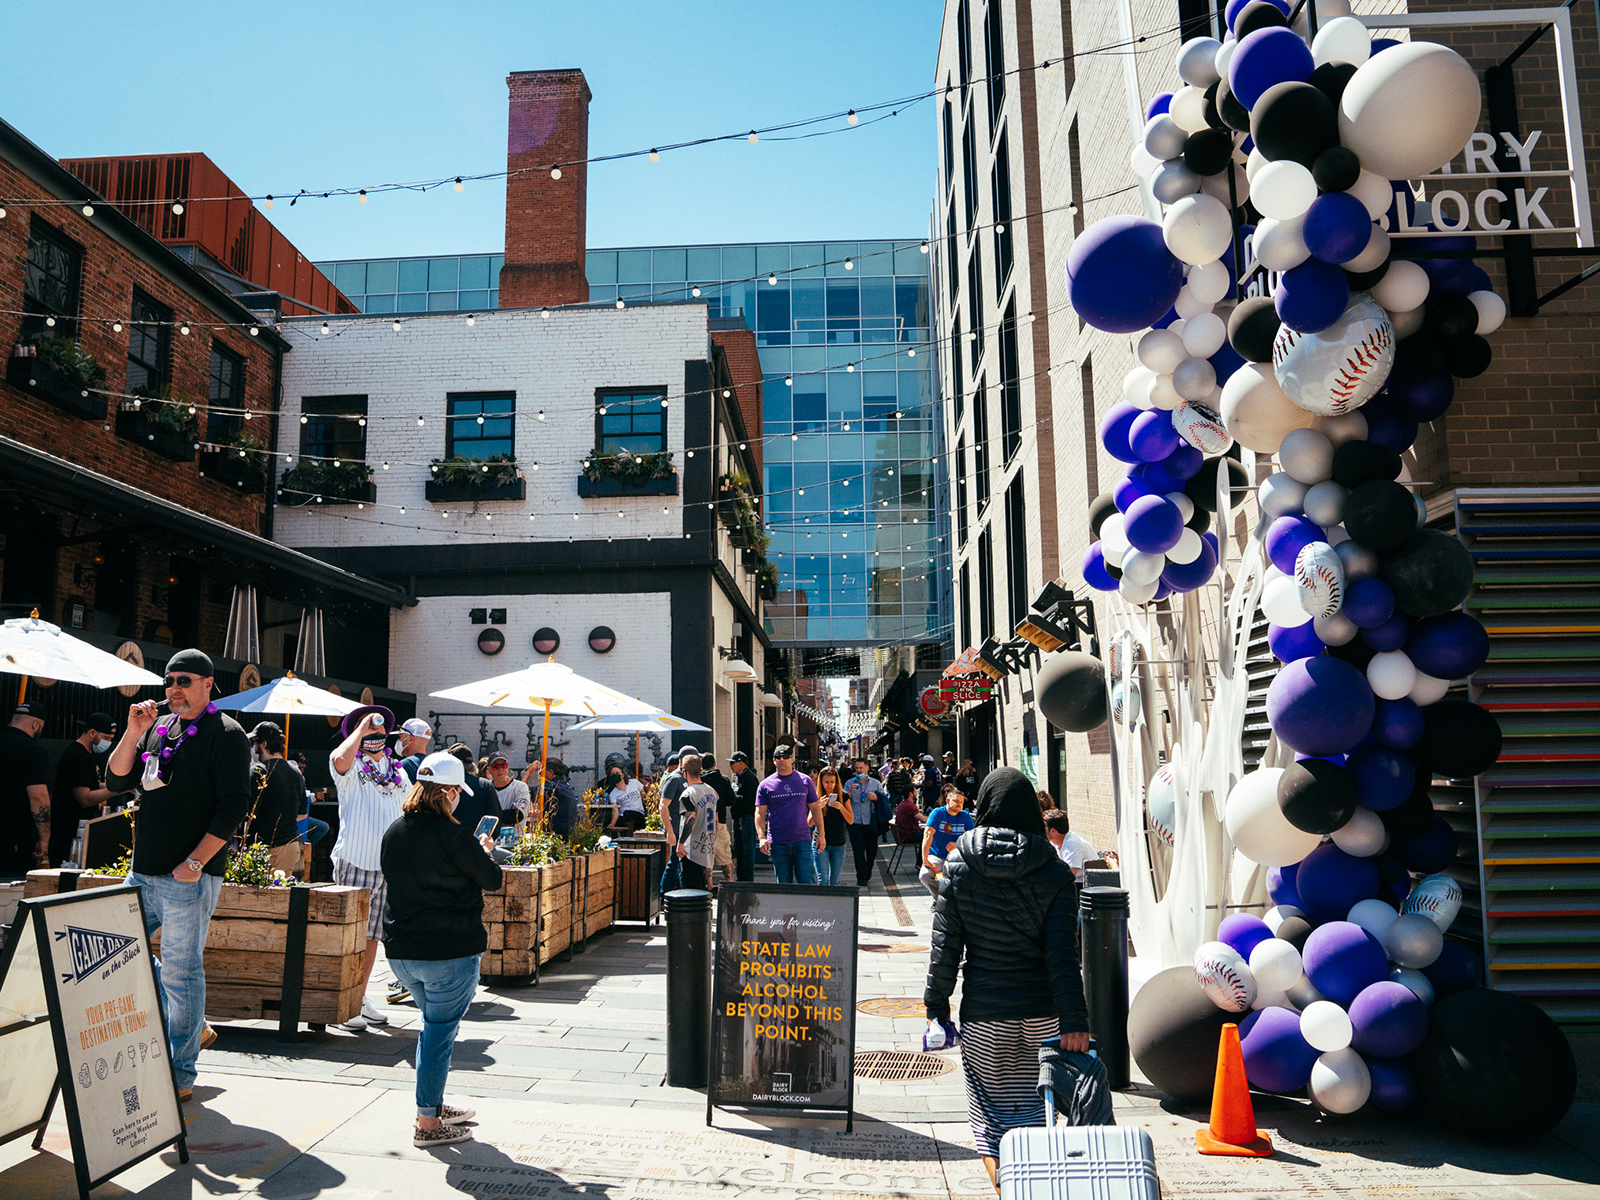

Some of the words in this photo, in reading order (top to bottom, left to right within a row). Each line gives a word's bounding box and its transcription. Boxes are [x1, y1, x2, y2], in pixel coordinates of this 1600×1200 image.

[1378, 187, 1555, 232] LOCK
[952, 691, 981, 700] SLICE
[740, 913, 767, 925] Thank
[769, 918, 786, 928] you
[787, 917, 800, 929] for
[801, 918, 836, 931] visiting!
[71, 932, 107, 975] GAME
[106, 937, 127, 954] DAY
[741, 940, 791, 957] STATE
[795, 942, 832, 959] LAW
[101, 969, 111, 980] on
[110, 960, 121, 972] the
[121, 944, 141, 966] Block
[740, 961, 832, 979] PROHIBITS
[741, 982, 828, 1000] ALCOHOL
[85, 1004, 105, 1026] YOUR
[104, 994, 136, 1020] PRE-GAME
[726, 1002, 799, 1019] BEYOND
[804, 1005, 842, 1021] THIS
[80, 1019, 126, 1051] DESTINATION,
[125, 1010, 148, 1034] FOUND!
[754, 1024, 813, 1041] POINT.
[752, 1093, 811, 1103] DAIRYBLOCK.COM
[112, 1127, 124, 1137] Scan
[124, 1121, 136, 1131] here
[150, 1110, 158, 1118] our
[116, 1131, 137, 1146] Opening
[136, 1118, 158, 1134] Weekend
[129, 1133, 148, 1148] Lineup!
[461, 1164, 508, 1174] DAIRY
[509, 1167, 560, 1177] BLOCK
[680, 1162, 993, 1191] welcome
[455, 1179, 551, 1198] tervetuloa
